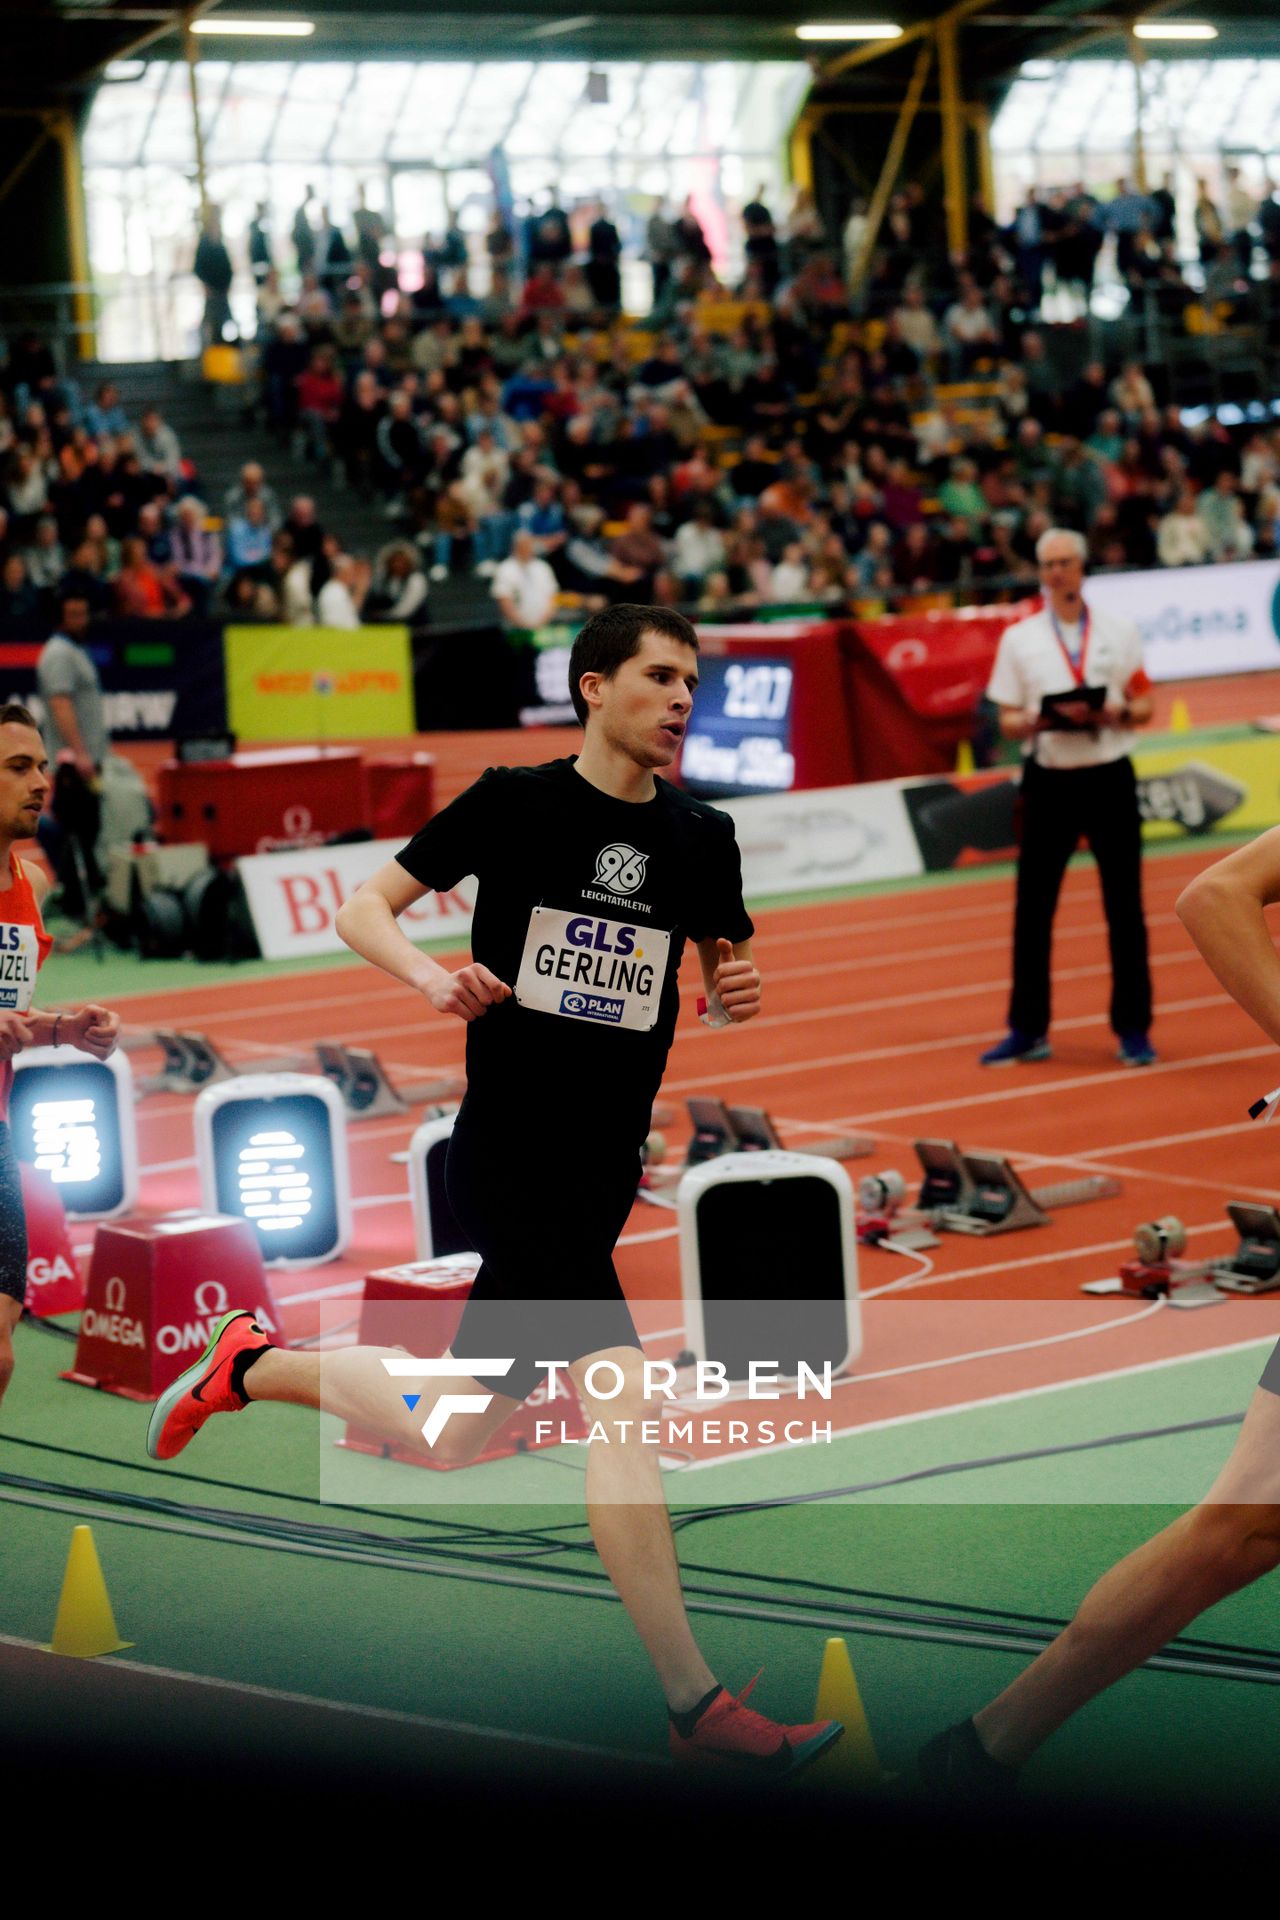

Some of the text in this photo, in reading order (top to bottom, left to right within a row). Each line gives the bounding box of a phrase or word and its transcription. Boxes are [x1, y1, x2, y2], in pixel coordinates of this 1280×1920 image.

[592, 843, 650, 895] 96
[581, 889, 652, 913] LEICHTATHLETIK
[535, 944, 654, 996] GERLING
[588, 999, 622, 1015] PLAN
[32, 1099, 101, 1183] 5
[238, 1131, 312, 1230] 6
[83, 1309, 146, 1348] OMEGA
